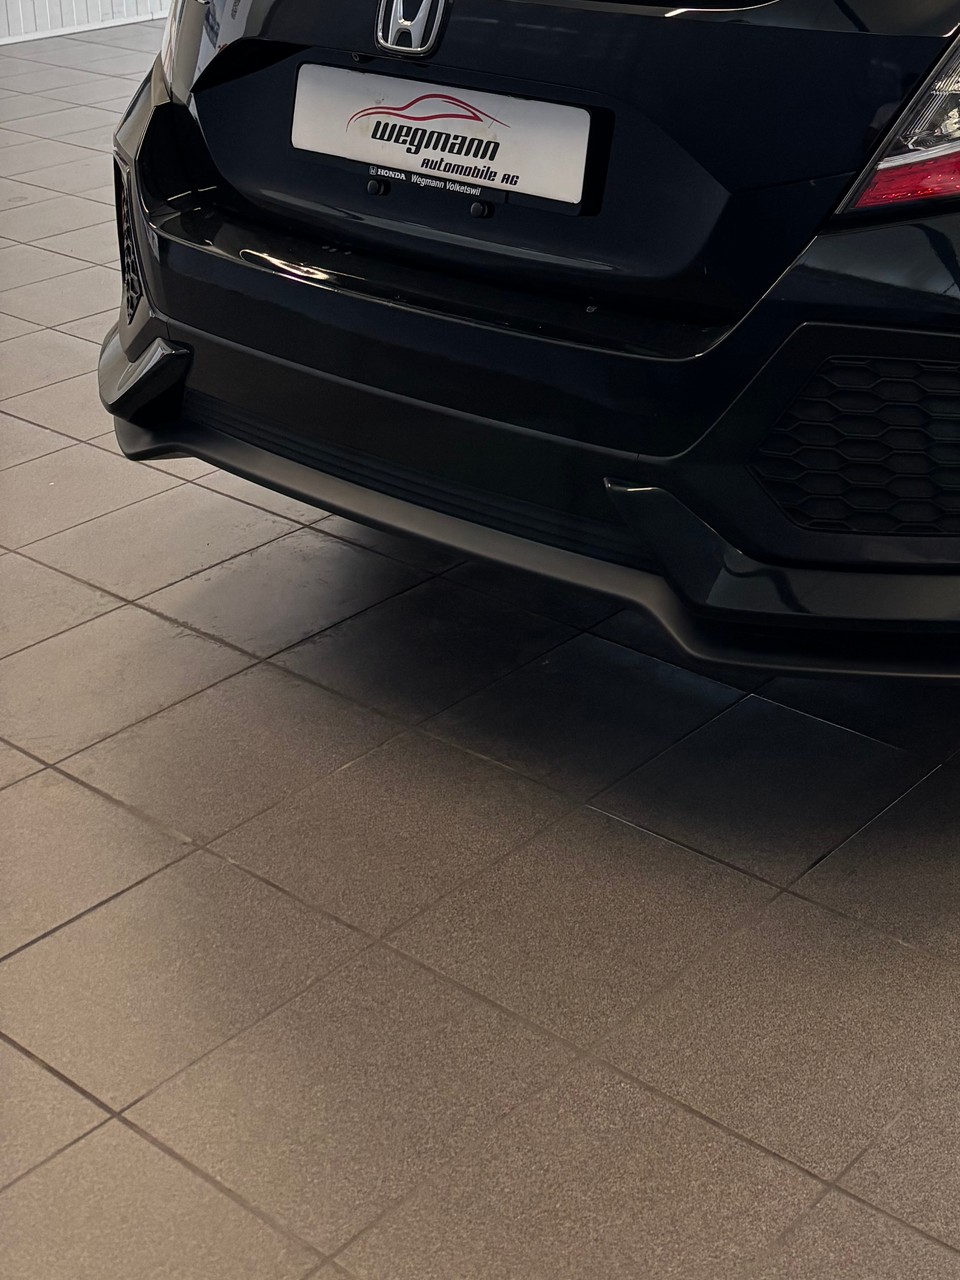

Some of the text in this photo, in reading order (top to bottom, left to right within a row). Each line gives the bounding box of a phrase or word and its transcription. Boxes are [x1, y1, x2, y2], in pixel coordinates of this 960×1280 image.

[371, 120, 500, 161] wegmann
[377, 168, 481, 196] HONDA Wegmann Volketswil
[500, 173, 519, 186] AG
